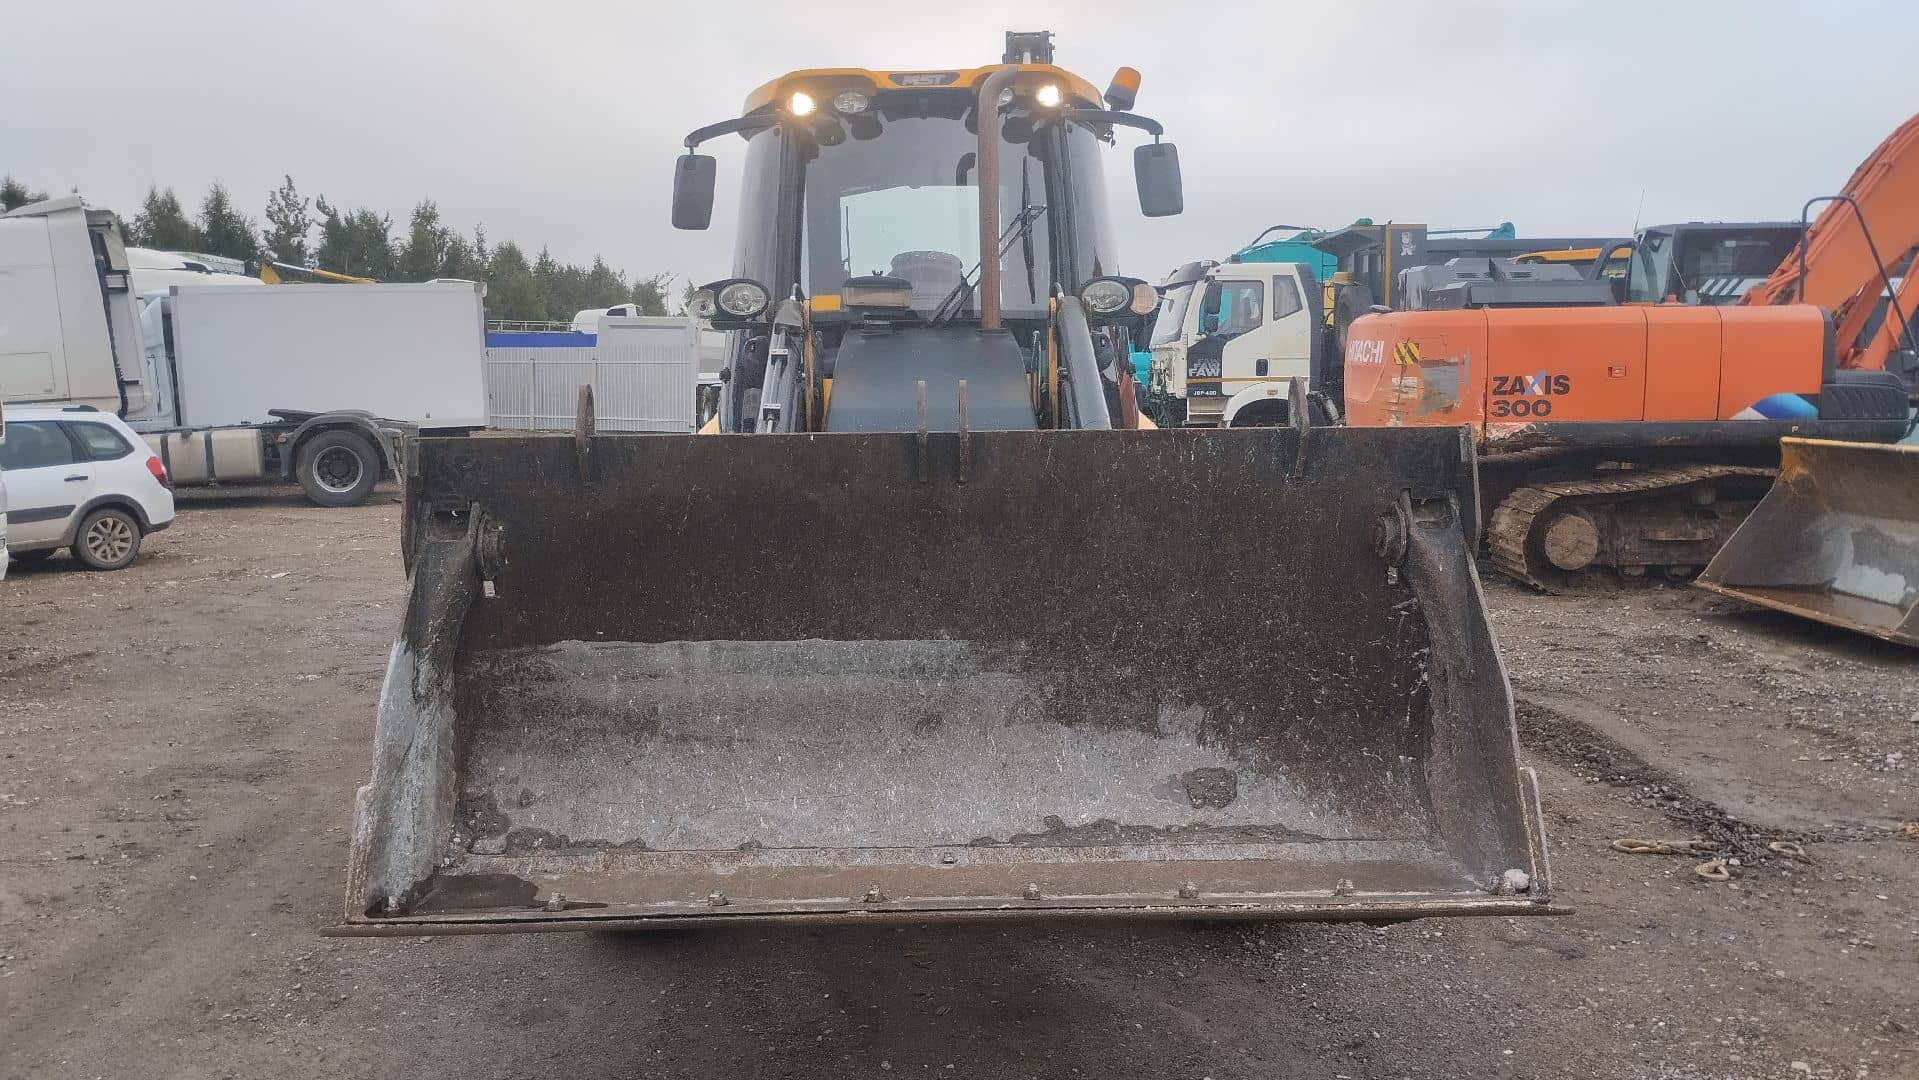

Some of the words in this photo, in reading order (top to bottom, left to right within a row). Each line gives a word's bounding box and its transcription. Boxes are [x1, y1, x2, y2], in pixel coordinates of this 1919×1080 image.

[1188, 367, 1220, 377] FAW
[1492, 370, 1570, 396] ZAXIS
[1491, 399, 1552, 417] 300
